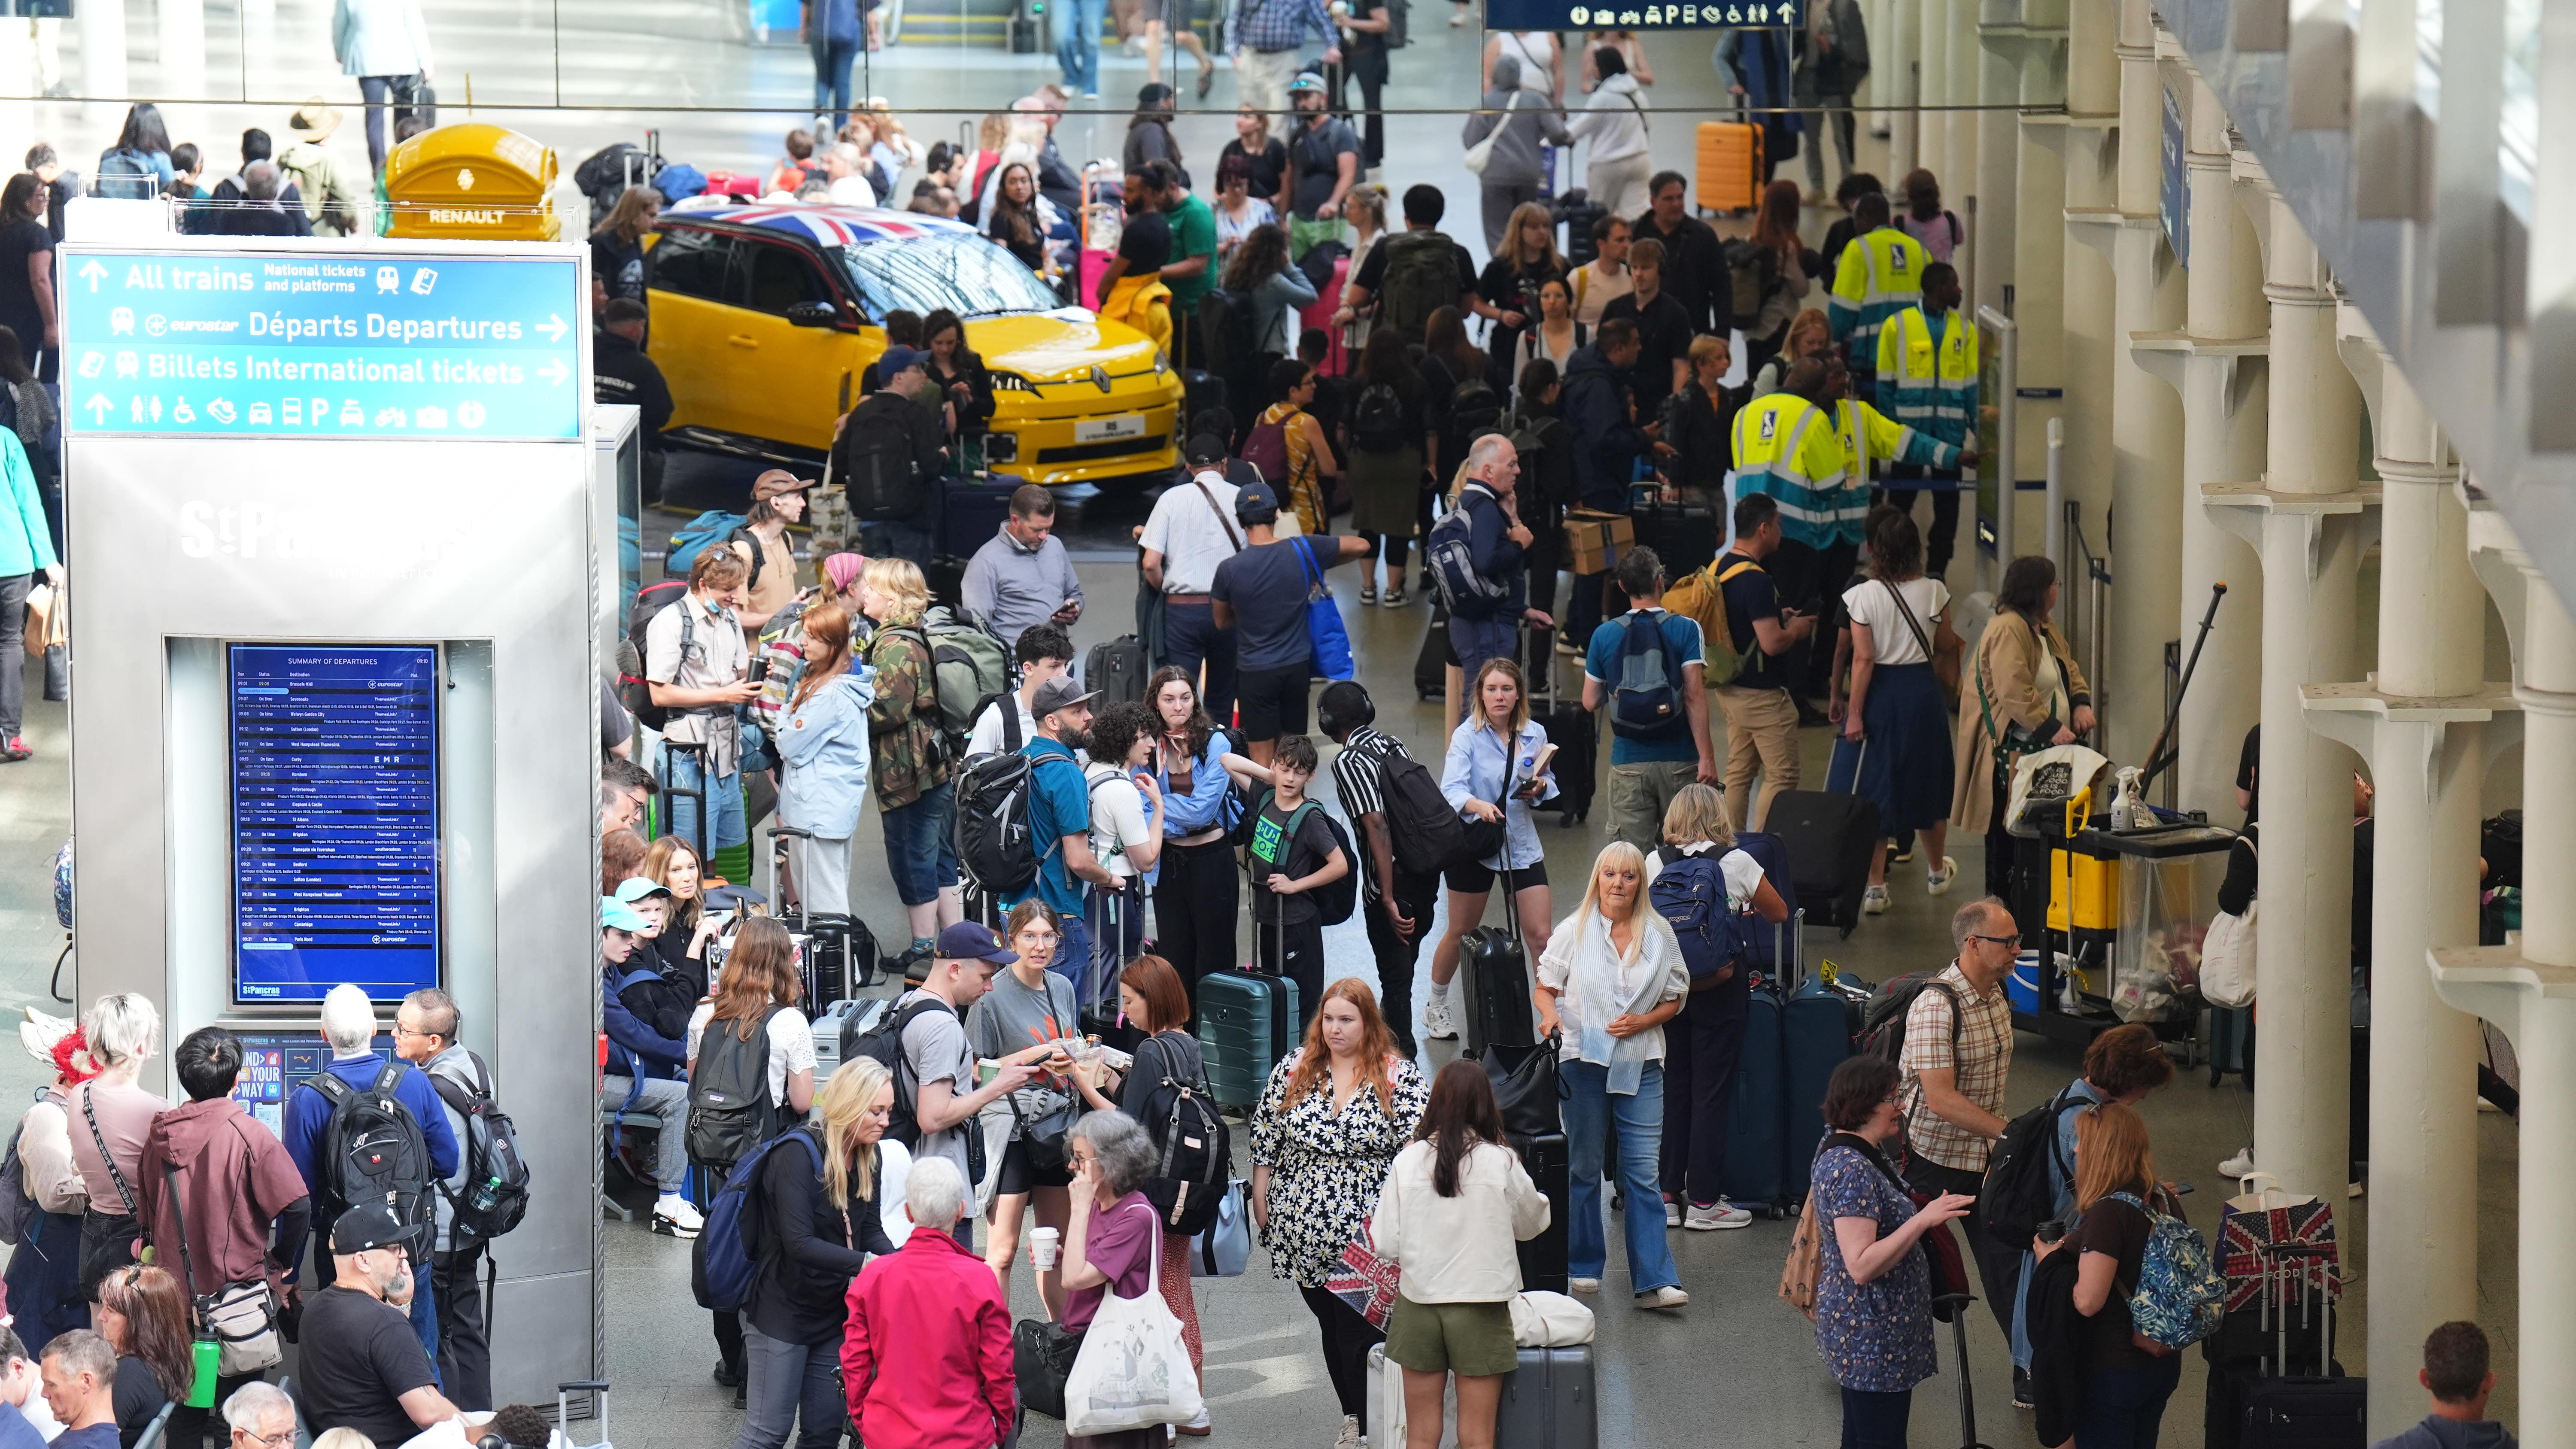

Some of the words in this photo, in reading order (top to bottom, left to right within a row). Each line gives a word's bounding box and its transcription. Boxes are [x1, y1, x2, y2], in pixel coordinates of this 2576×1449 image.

[1666, 4, 1679, 24] P
[429, 210, 506, 224] RENAULT
[126, 264, 164, 289] All
[172, 267, 254, 291] trains
[264, 263, 319, 277] National
[322, 264, 366, 278] tickets
[264, 279, 288, 292] and
[292, 280, 356, 294] platforms
[170, 320, 239, 333] eurostar
[249, 311, 358, 342] Départs
[367, 313, 522, 344] Departures
[149, 353, 238, 379] Billets
[247, 355, 425, 383] International
[432, 359, 524, 384] tickets
[311, 398, 329, 426] P
[243, 1051, 260, 1066] IND
[251, 1066, 280, 1082] YOUR
